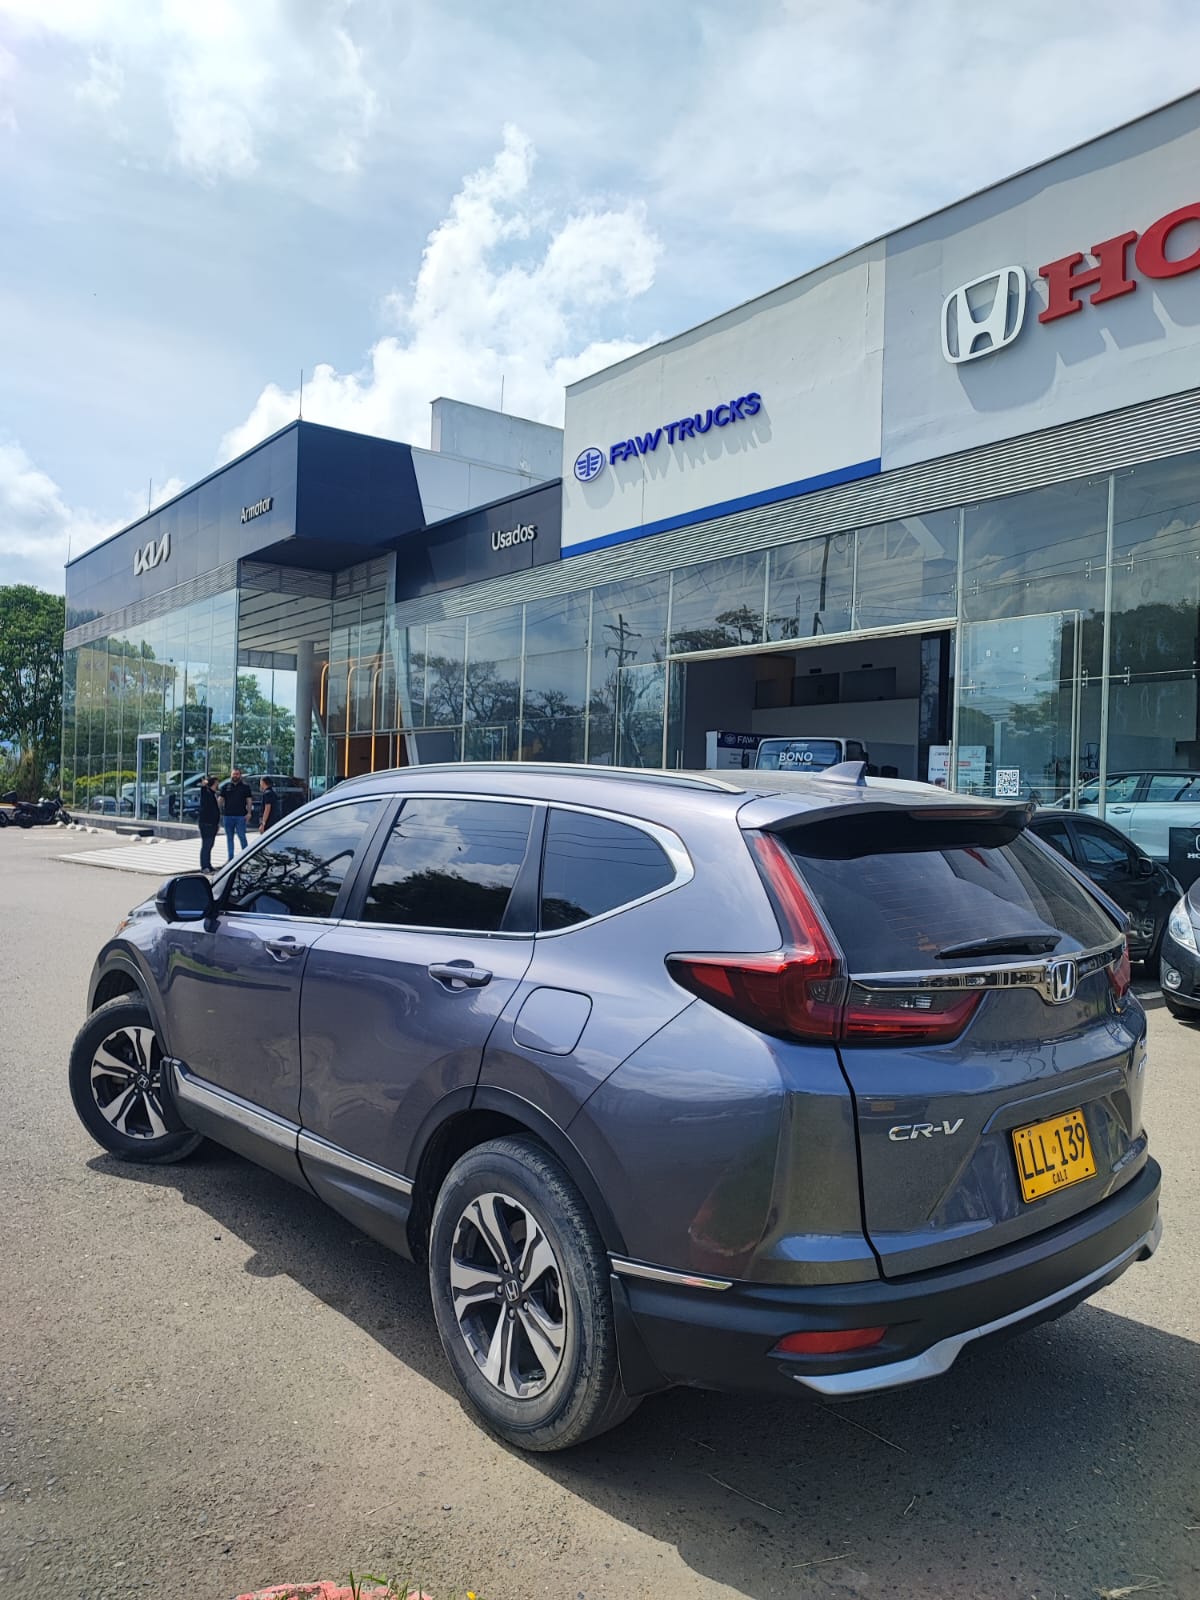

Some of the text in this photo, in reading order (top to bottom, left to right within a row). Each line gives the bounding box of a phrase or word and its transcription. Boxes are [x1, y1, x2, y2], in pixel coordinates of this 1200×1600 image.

[609, 391, 762, 466] FAW TRUCKS
[240, 497, 273, 523] Armotor
[491, 523, 537, 551] Usados
[133, 532, 171, 577] KIA
[779, 751, 813, 762] BONO
[888, 1118, 964, 1142] CR-V
[1052, 1174, 1068, 1185] CALI
